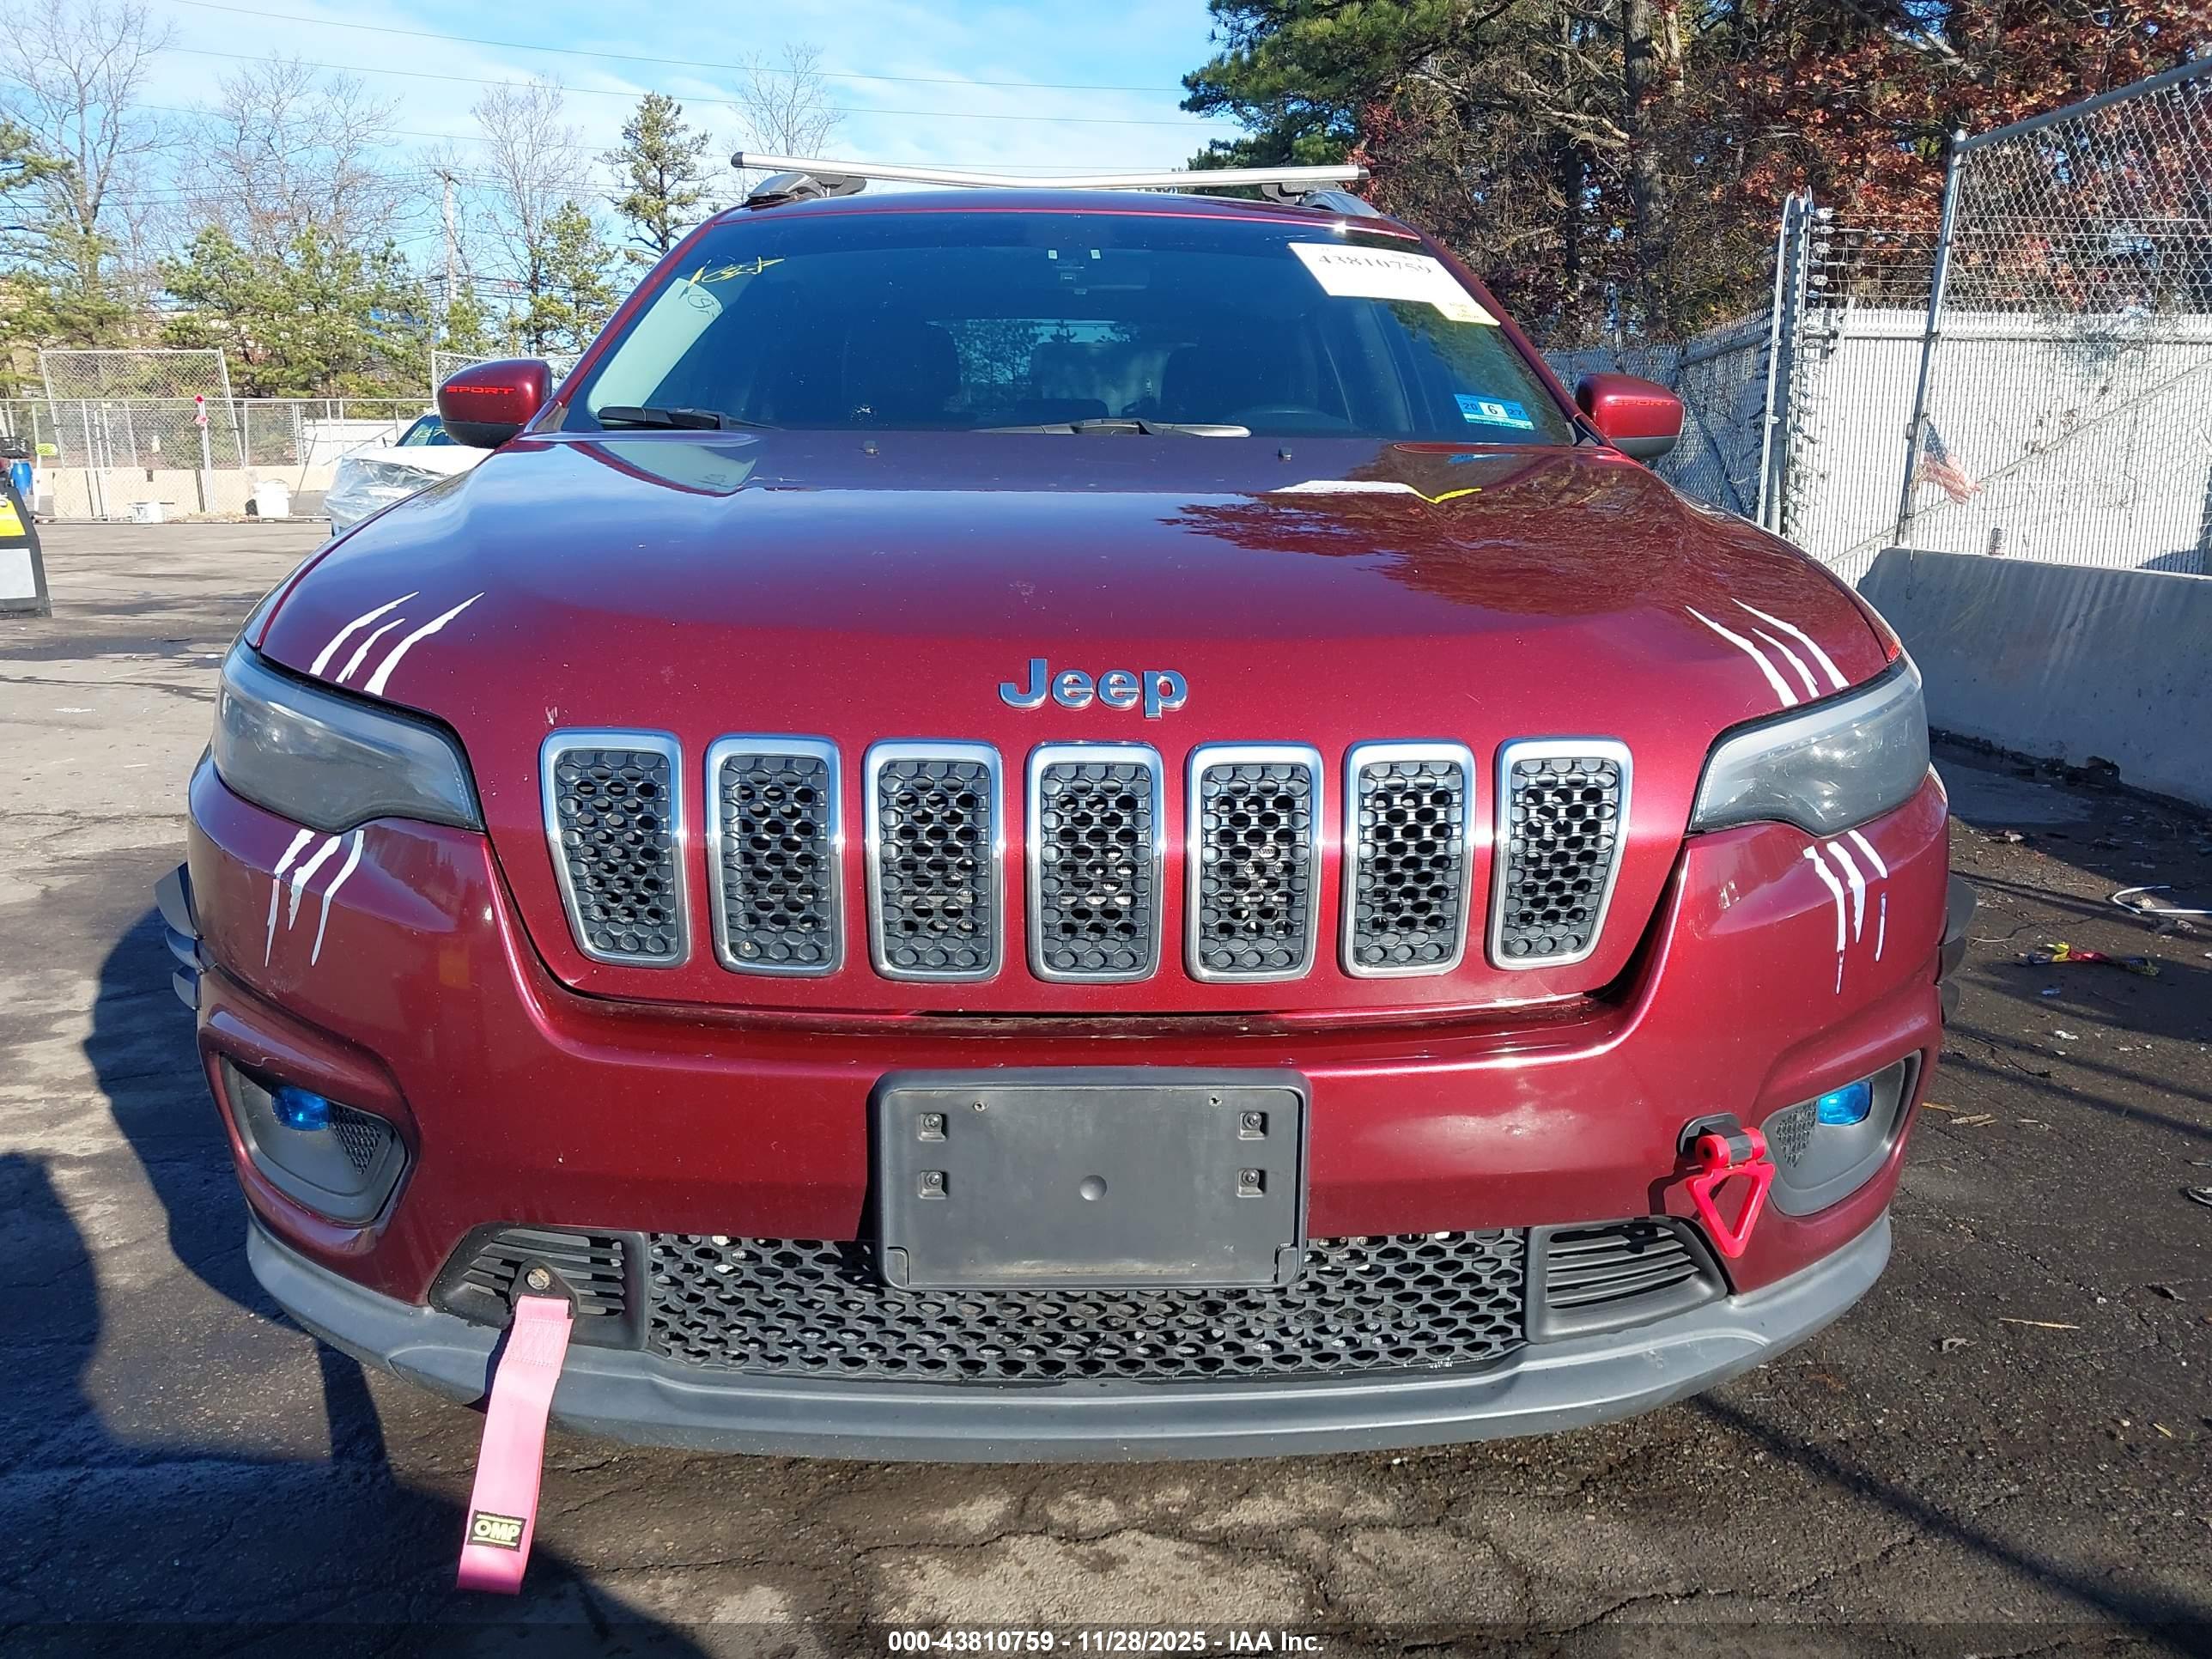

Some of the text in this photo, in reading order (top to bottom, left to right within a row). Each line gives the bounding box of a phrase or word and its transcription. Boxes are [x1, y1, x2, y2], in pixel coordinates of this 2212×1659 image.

[446, 386, 515, 395] SPORT
[1462, 402, 1479, 411] 20
[1487, 404, 1498, 415] 6
[998, 658, 1189, 720] Jeep
[474, 1519, 521, 1542] OMP
